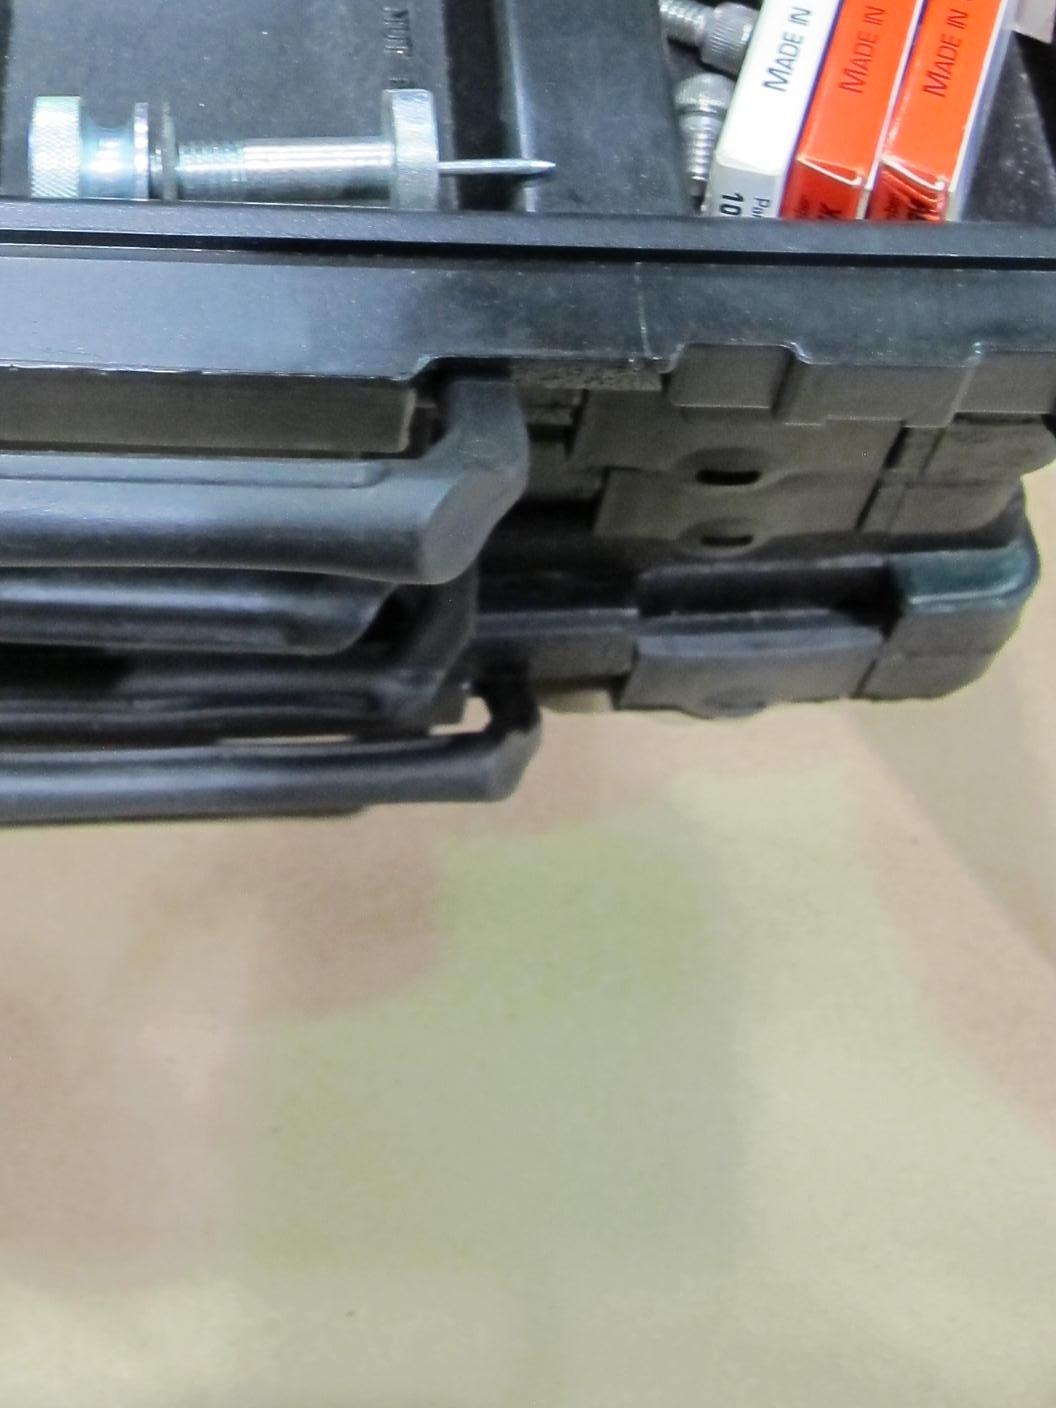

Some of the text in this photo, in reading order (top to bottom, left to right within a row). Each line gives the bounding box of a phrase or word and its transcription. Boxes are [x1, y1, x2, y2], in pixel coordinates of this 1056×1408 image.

[761, 31, 805, 93] MADE
[788, 6, 812, 27] IN
[839, 29, 880, 94] MADE
[863, 5, 886, 26] IN
[921, 32, 962, 98] MADE
[946, 7, 970, 30] IN
